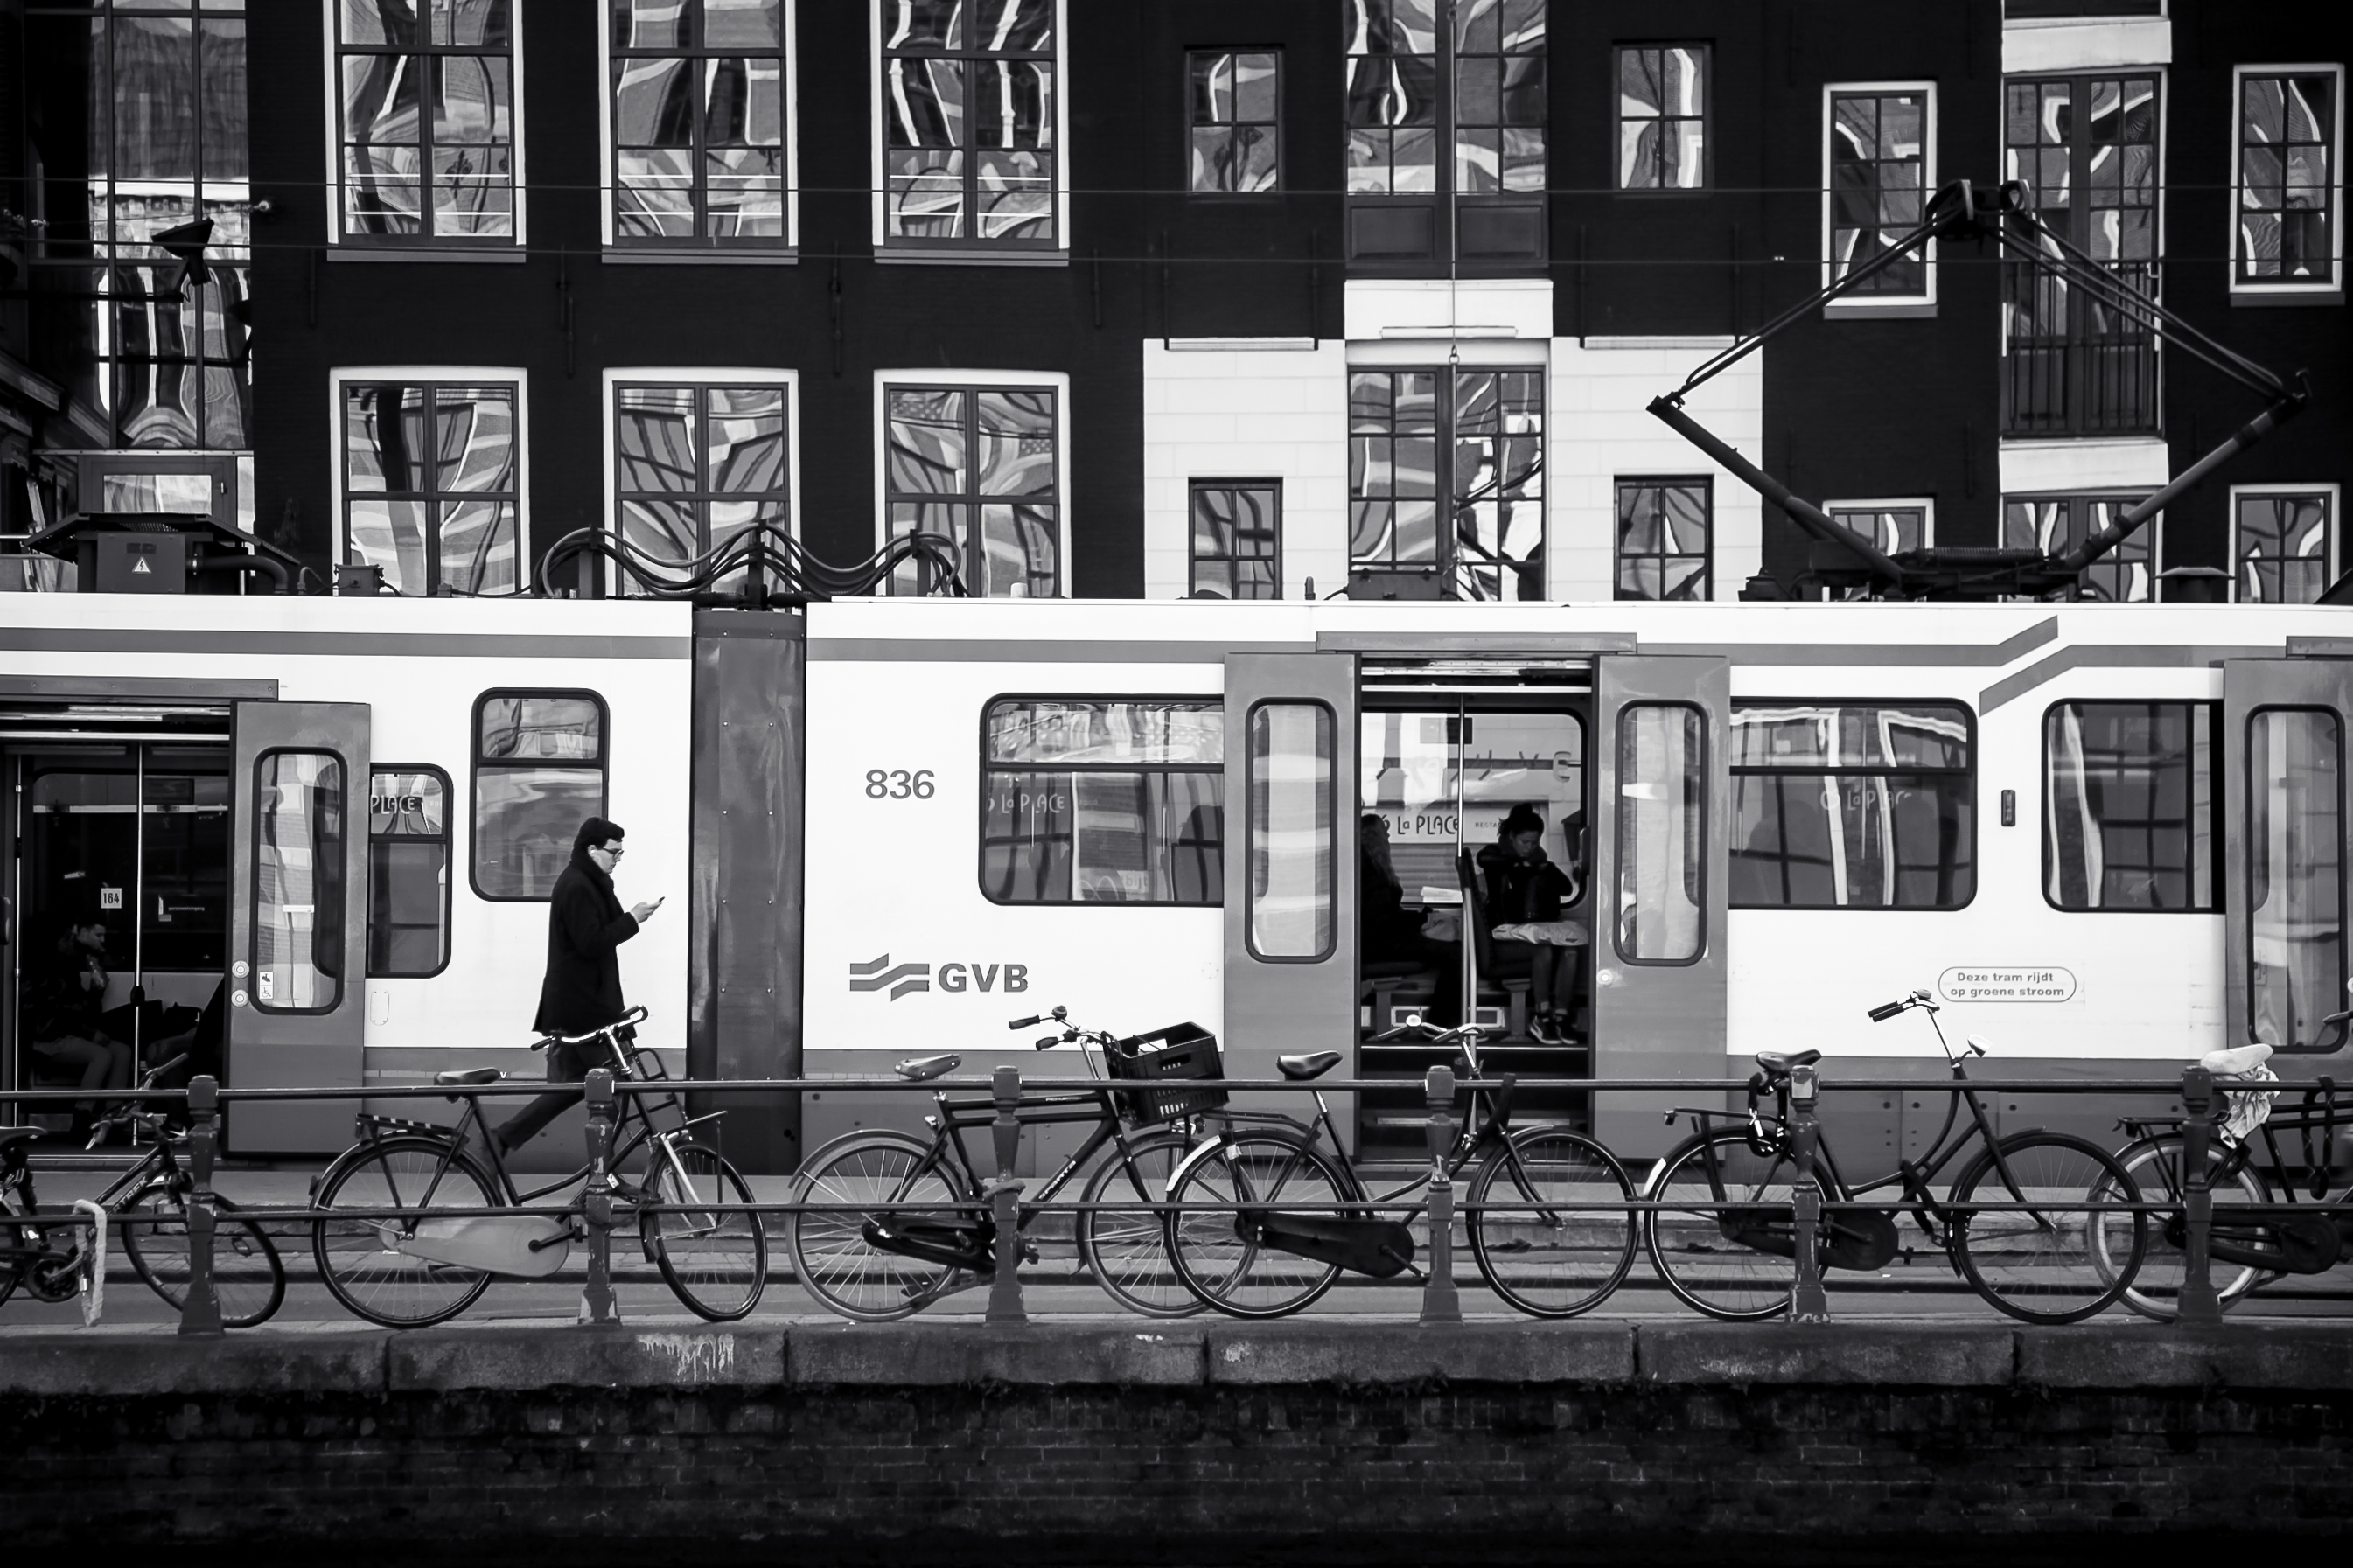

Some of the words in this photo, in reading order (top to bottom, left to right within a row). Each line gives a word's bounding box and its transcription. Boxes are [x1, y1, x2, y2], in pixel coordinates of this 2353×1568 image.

[865, 769, 935, 799] 836
[371, 794, 415, 814] PLACE
[1020, 793, 1065, 813] PACE
[1397, 815, 1411, 834] La
[103, 892, 120, 904] 164
[938, 962, 1029, 993] GVB
[1957, 972, 1988, 982] Deze
[1993, 972, 2022, 982] tram
[2027, 972, 2054, 984] rijdt
[1950, 988, 1965, 998] op
[1970, 988, 2014, 998] groene
[2019, 986, 2064, 996] stroom
